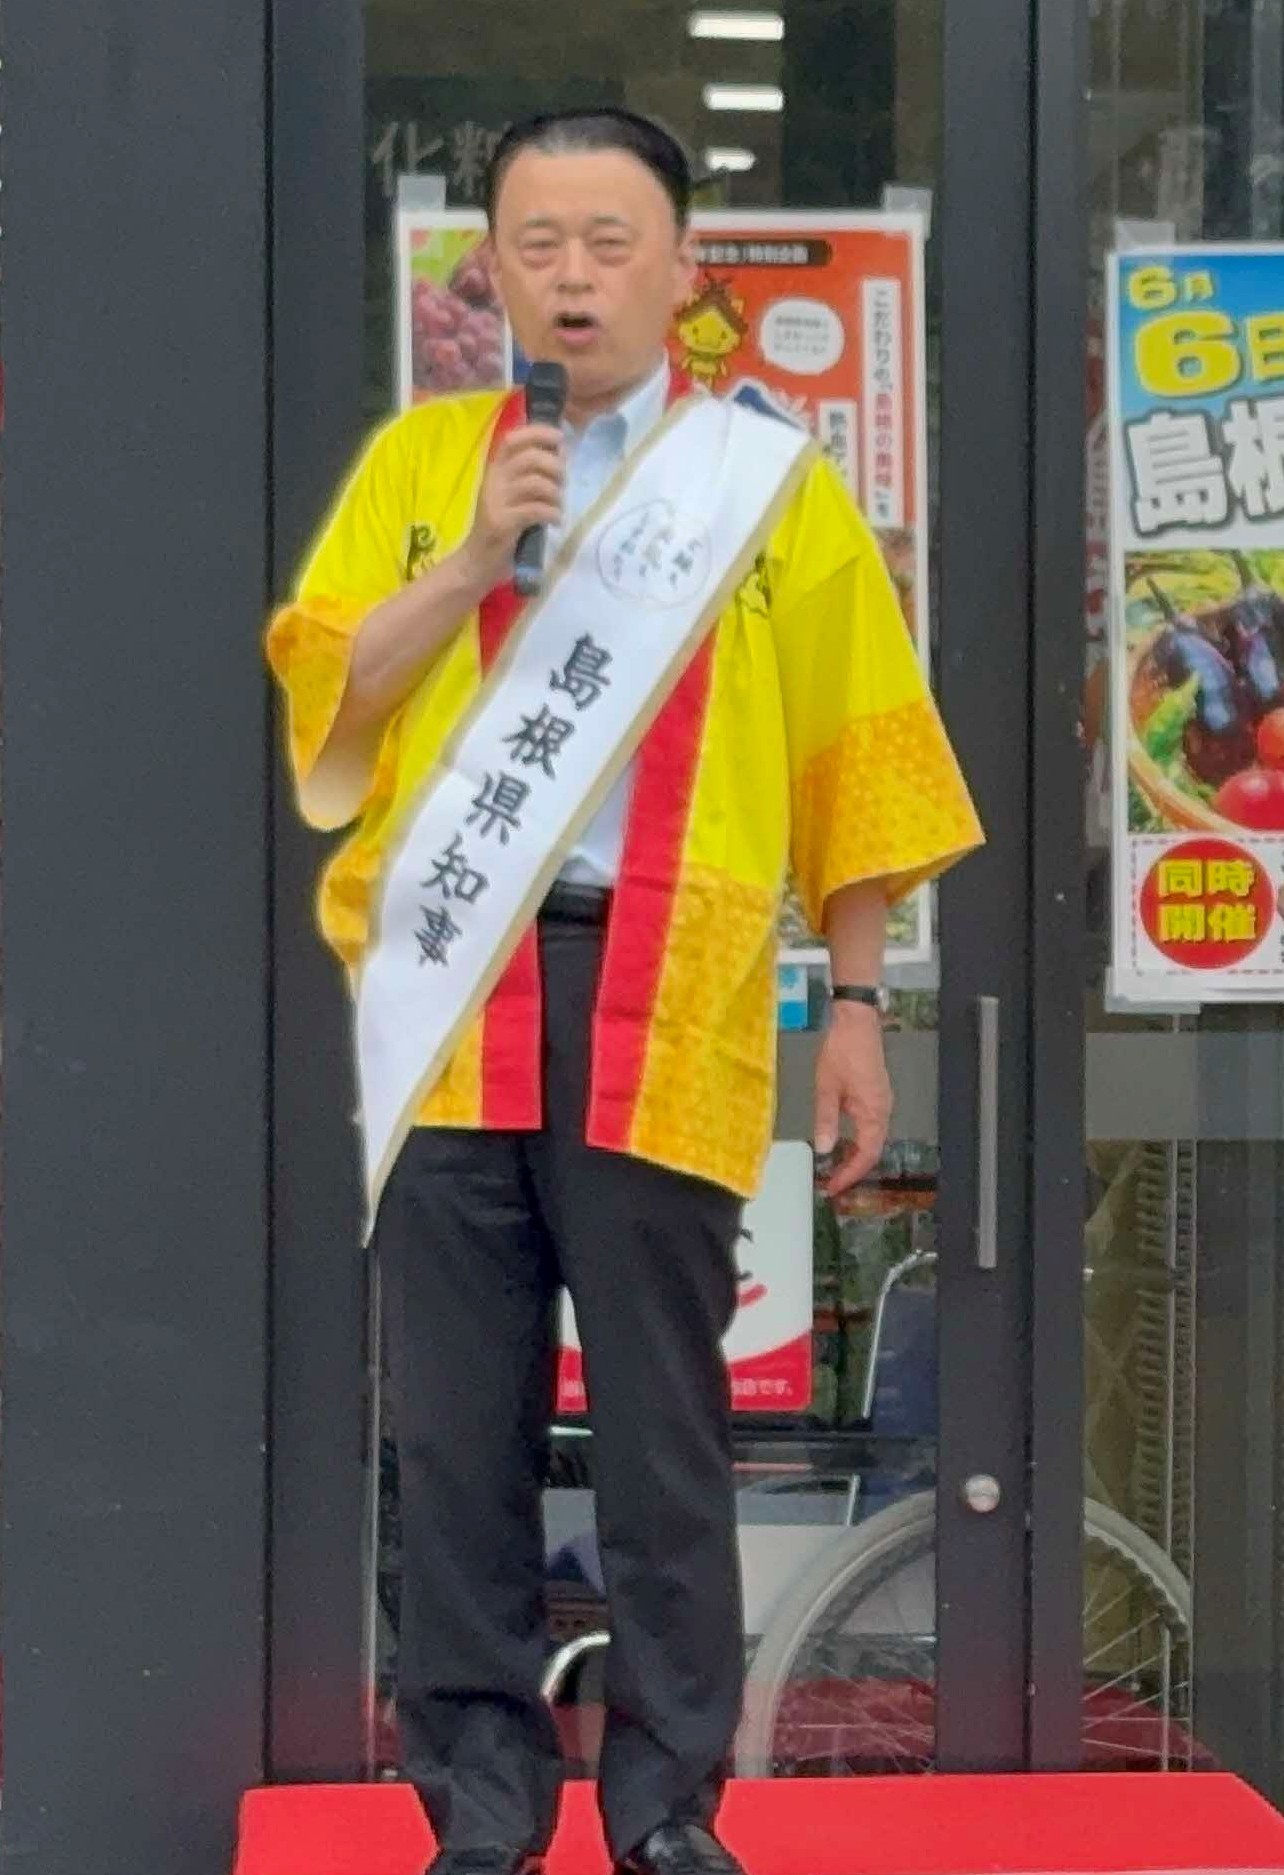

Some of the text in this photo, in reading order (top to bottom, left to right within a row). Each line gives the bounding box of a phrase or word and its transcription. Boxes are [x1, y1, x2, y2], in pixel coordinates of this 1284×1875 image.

[1126, 267, 1214, 309] 6月
[410, 634, 612, 966] 島根県知事
[1159, 858, 1256, 897] 同時
[1159, 903, 1257, 942] 開催
